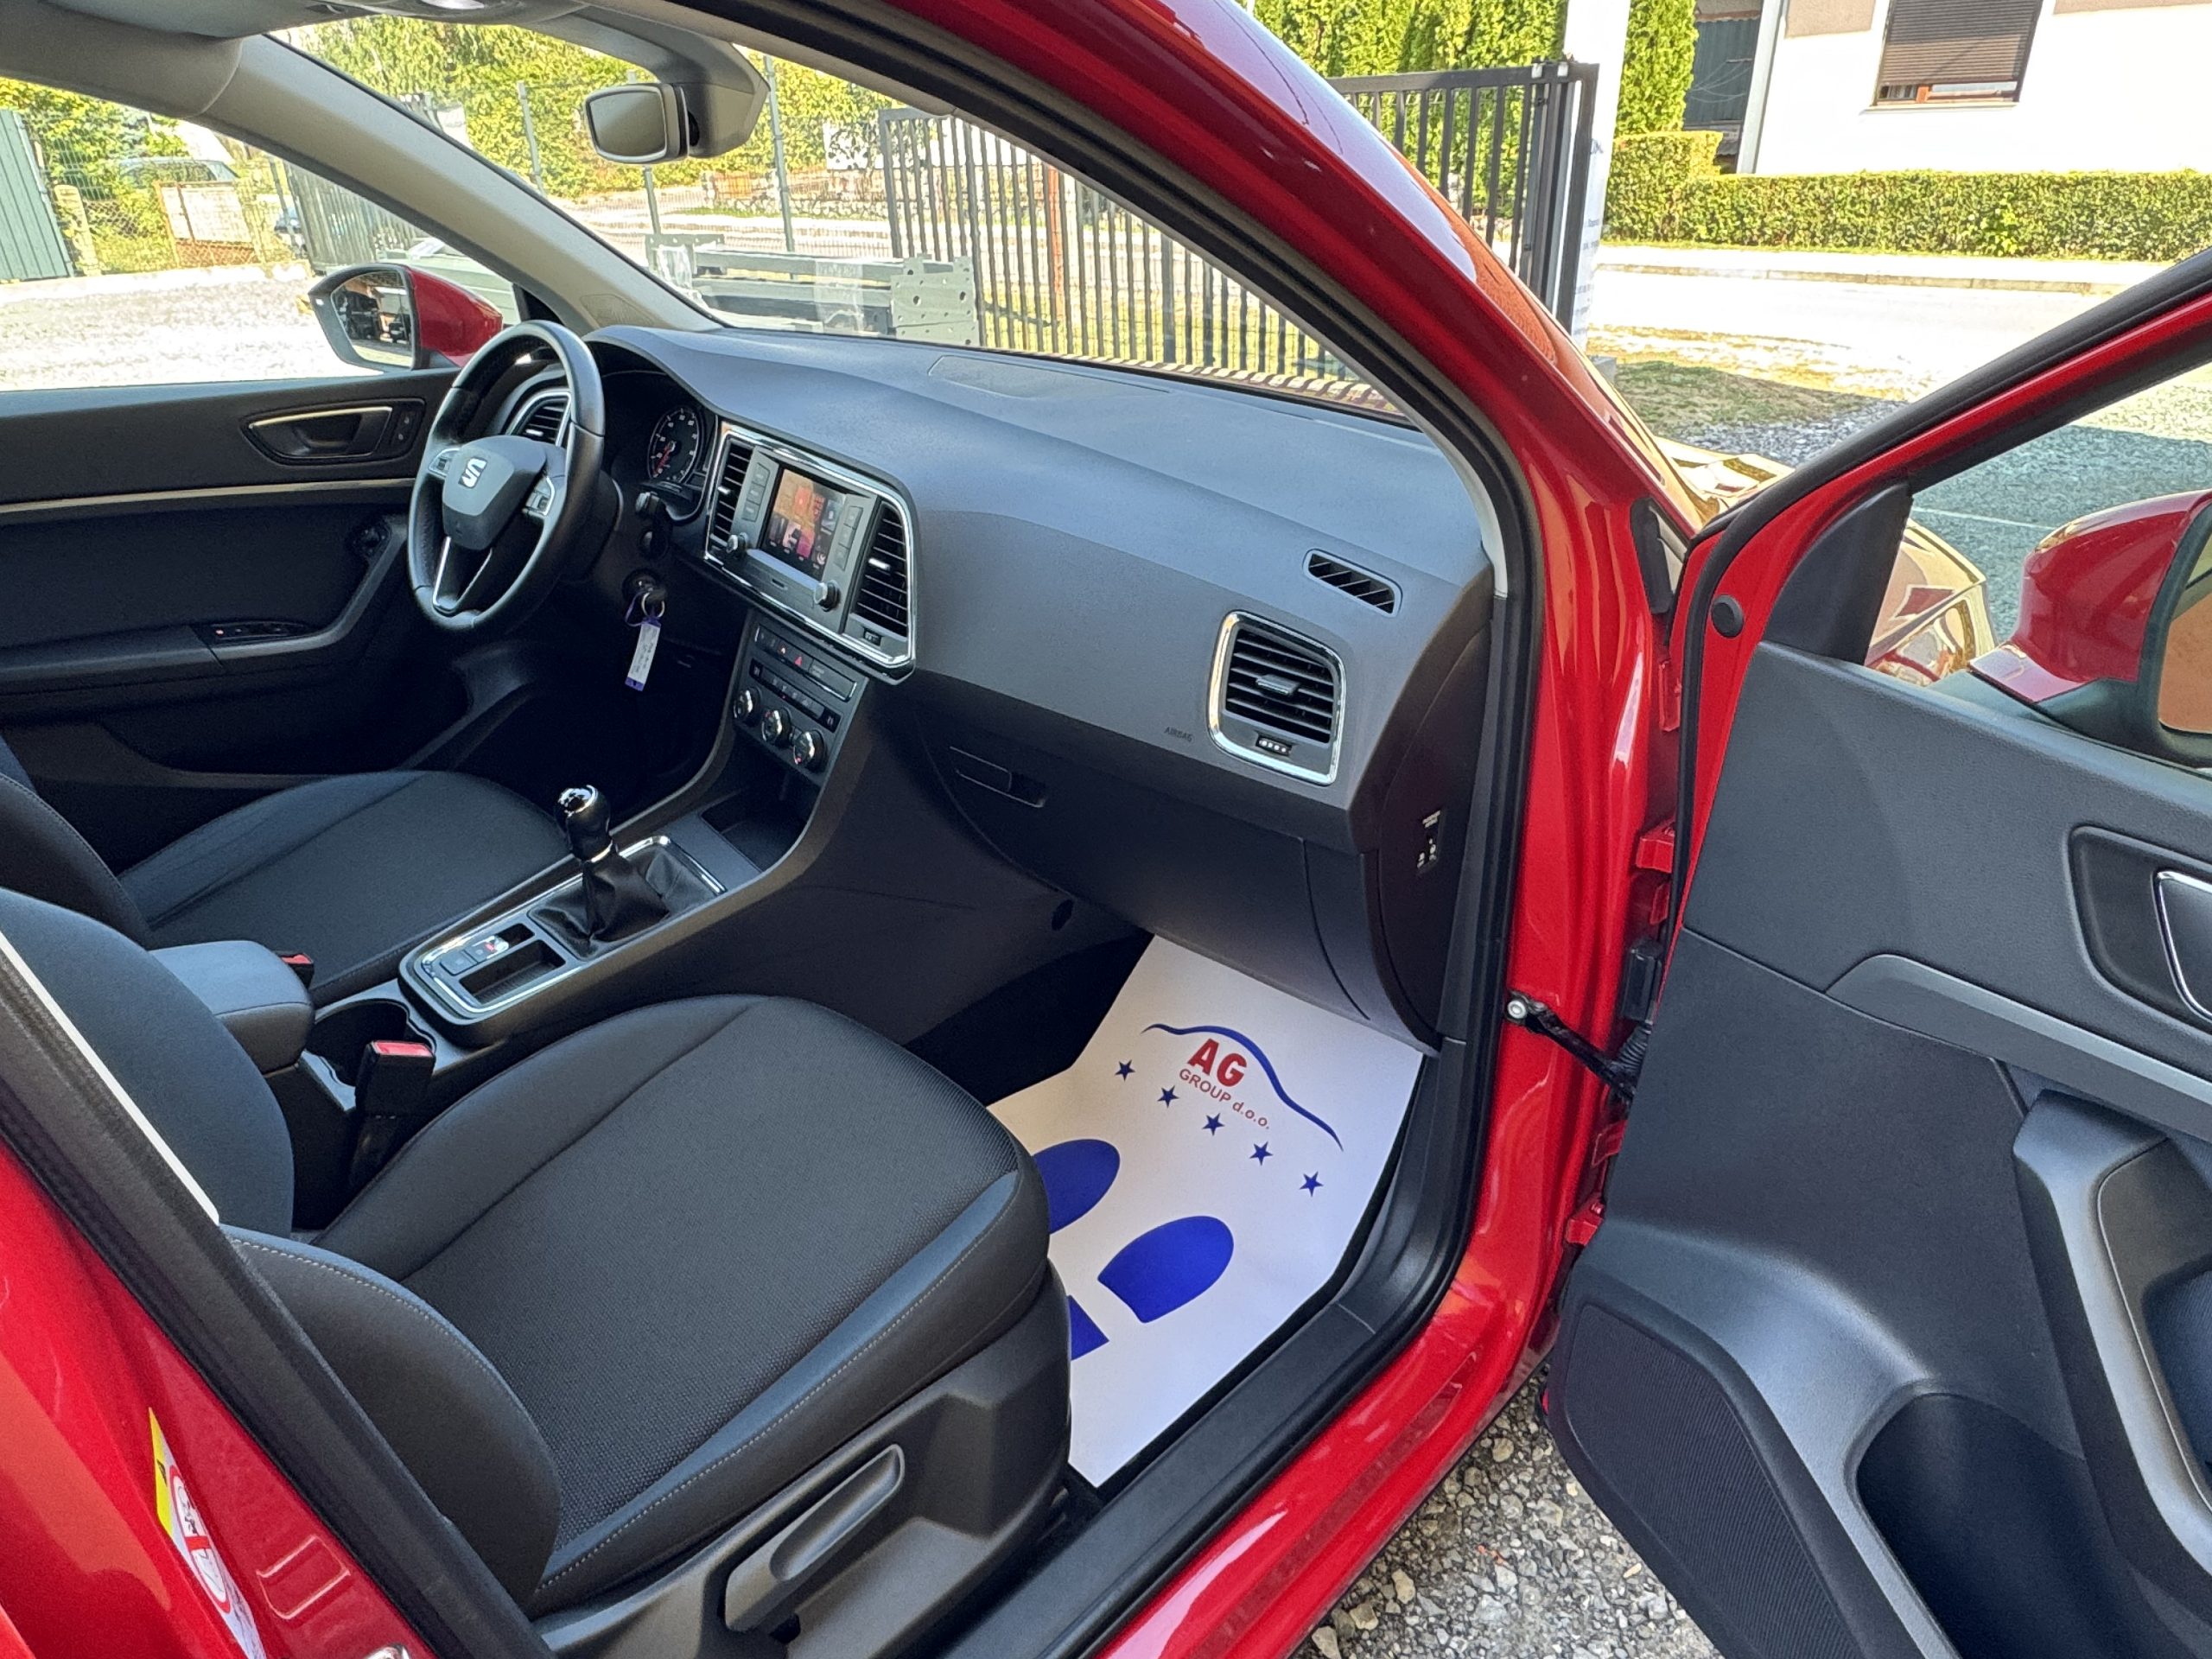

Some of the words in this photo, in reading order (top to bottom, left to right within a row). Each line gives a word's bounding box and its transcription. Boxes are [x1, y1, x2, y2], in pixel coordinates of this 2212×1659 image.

[1164, 726, 1193, 743] AIRBAG
[1186, 1038, 1248, 1087] AG
[1179, 1068, 1231, 1103] GROUP
